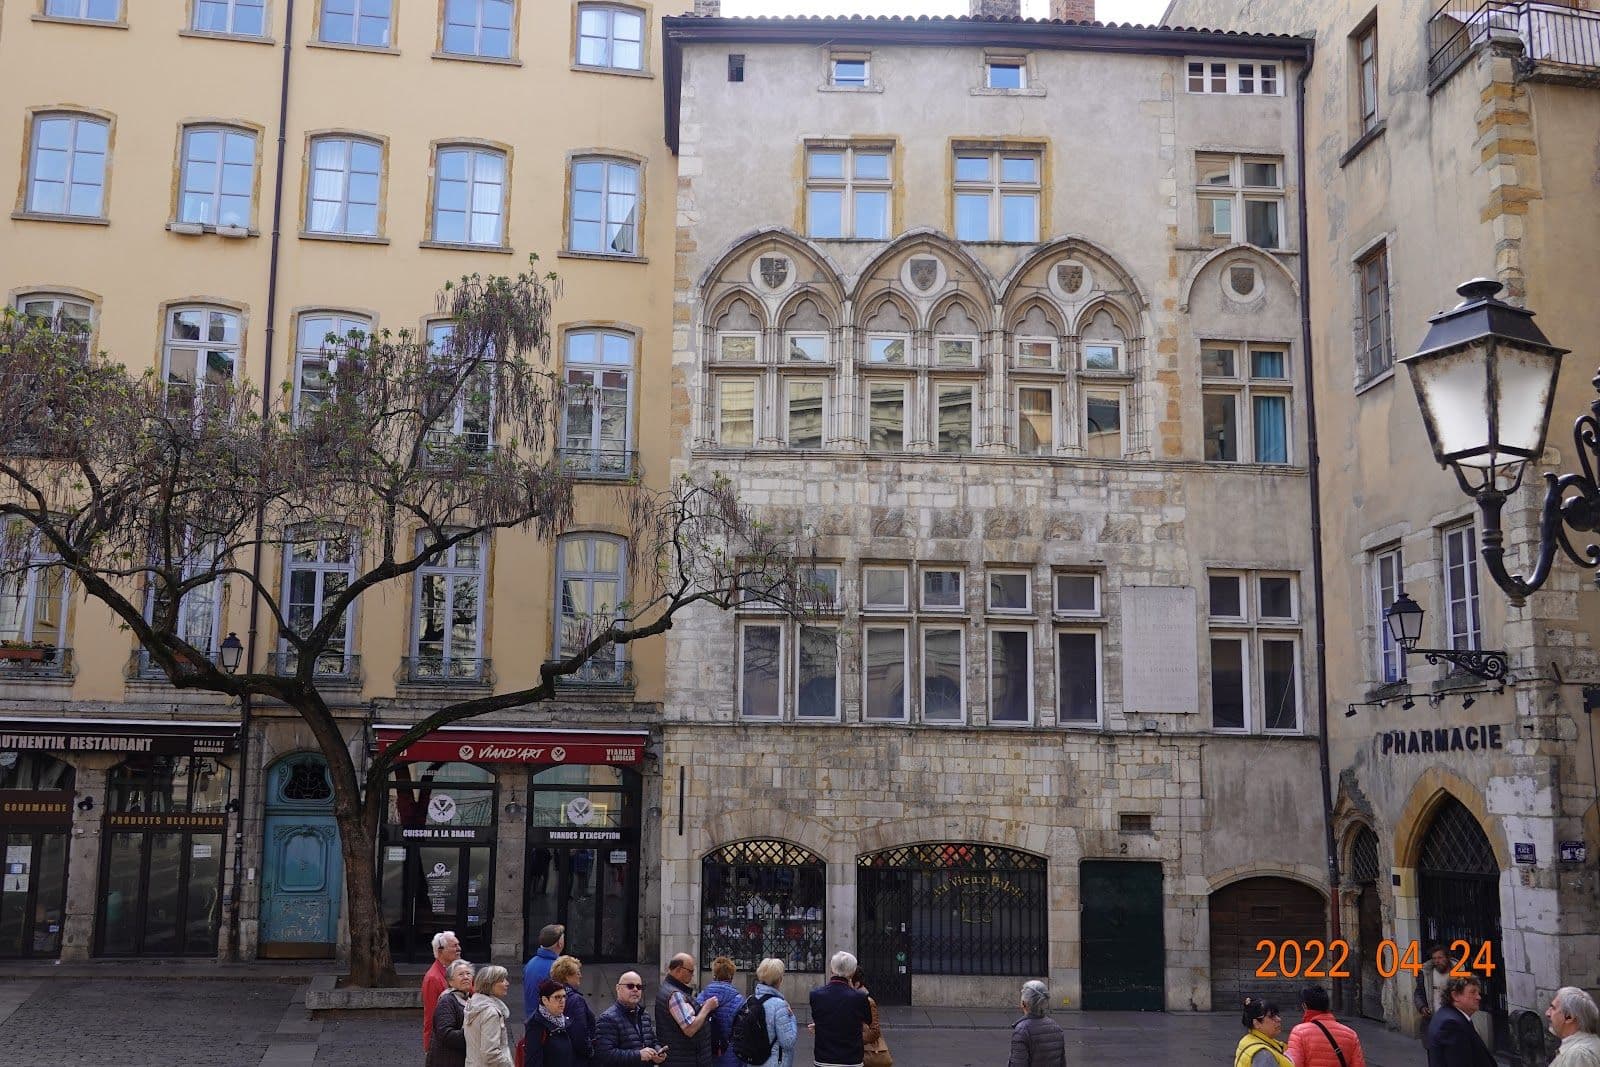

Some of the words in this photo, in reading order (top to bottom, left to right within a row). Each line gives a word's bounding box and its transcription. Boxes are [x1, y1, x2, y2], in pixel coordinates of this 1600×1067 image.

[0, 735, 66, 749] UTHENTIK
[70, 736, 153, 752] RESTAURANT
[1383, 724, 1502, 755] PHARMACIE
[4, 803, 68, 813] GOURMANDE
[110, 816, 161, 826] PRODUITS
[403, 829, 433, 838] CUISSON
[434, 829, 440, 838] A
[441, 830, 449, 838] LA
[451, 830, 476, 838] BRAISE
[549, 831, 578, 840] VIANDES
[580, 831, 621, 840] D'EXCEPTION
[1119, 842, 1128, 854] 2
